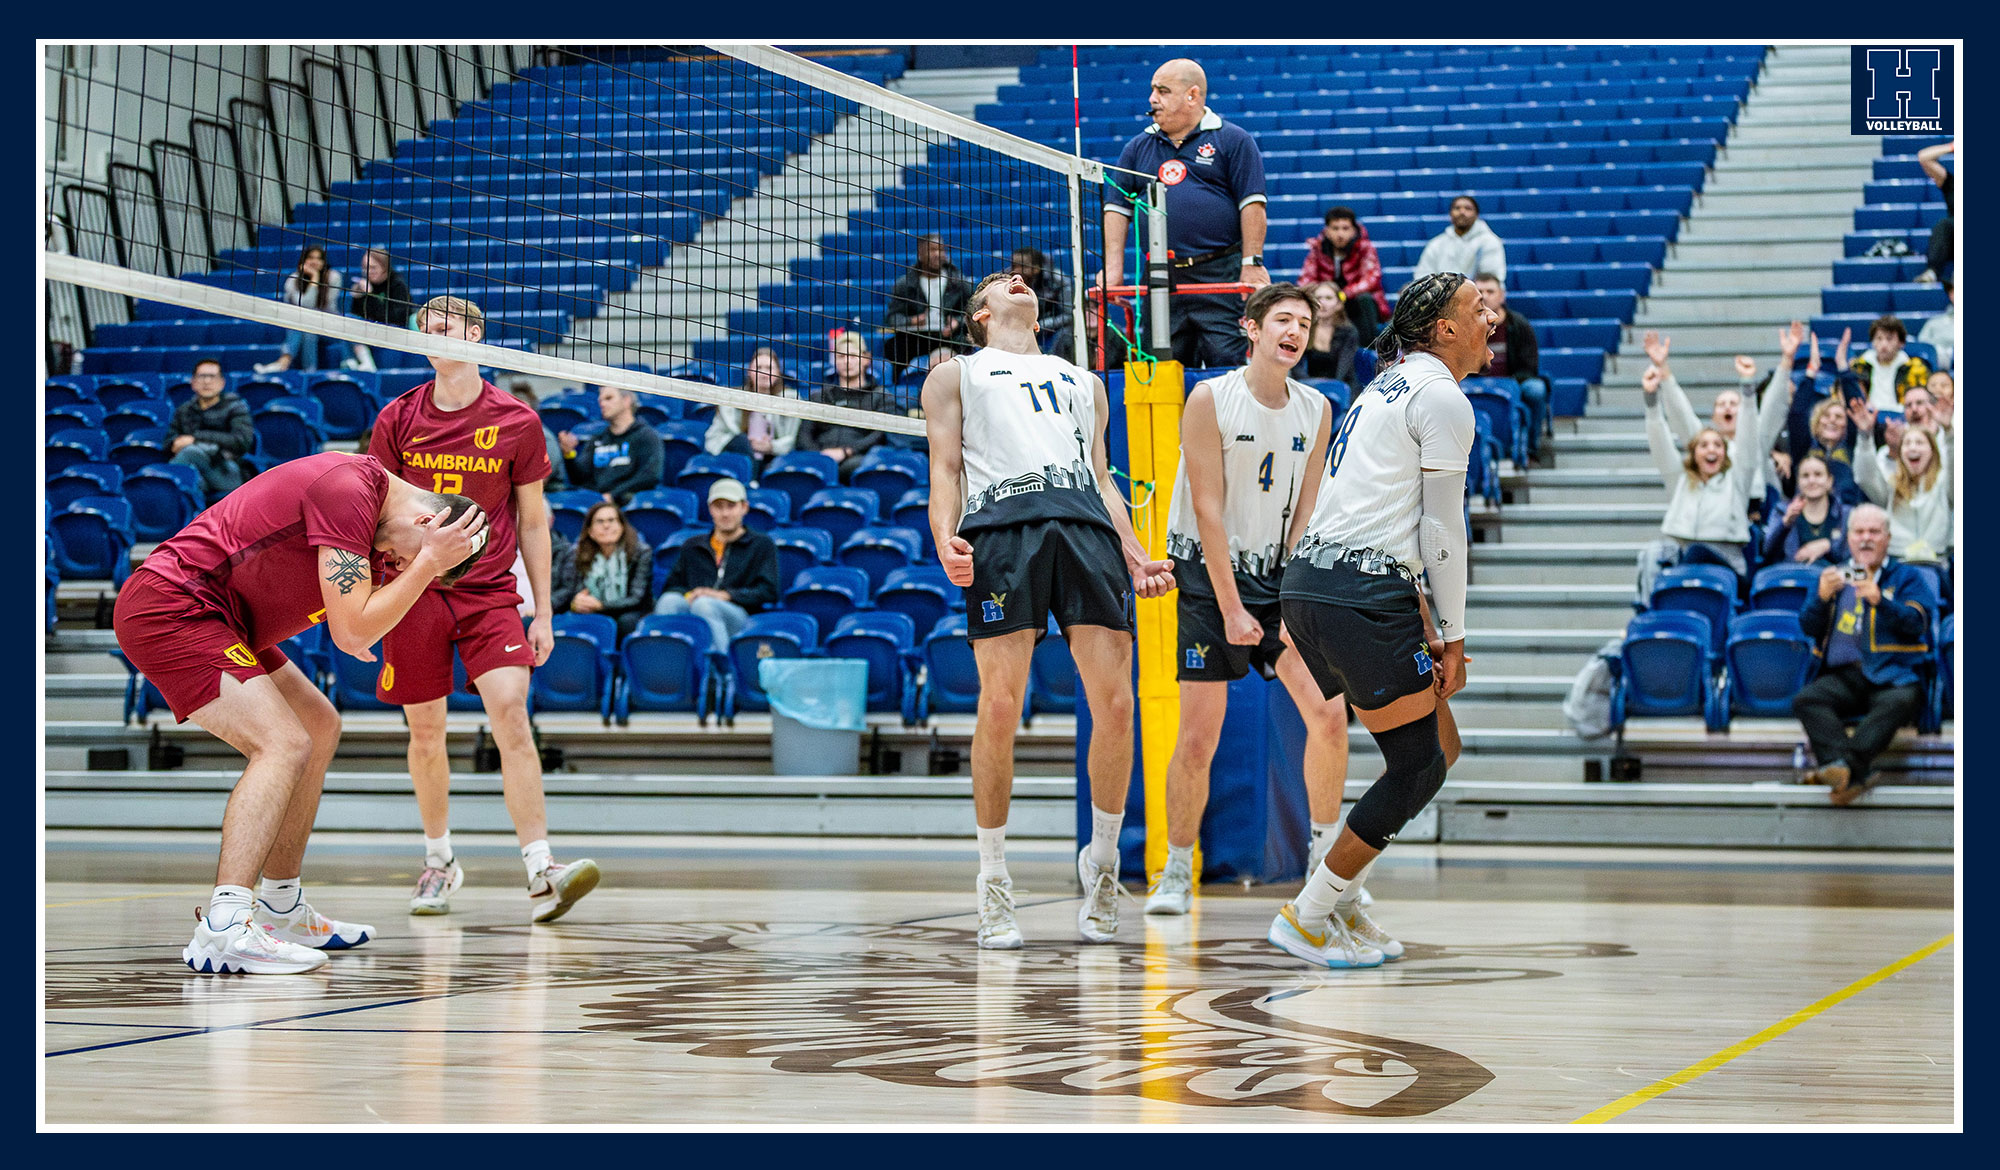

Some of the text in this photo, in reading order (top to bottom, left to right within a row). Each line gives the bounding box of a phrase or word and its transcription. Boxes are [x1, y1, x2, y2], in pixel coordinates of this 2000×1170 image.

[1020, 381, 1061, 414] 11
[1330, 404, 1363, 478] 8
[402, 451, 502, 473] CAMBRIAN
[1258, 451, 1275, 492] 4
[981, 600, 1005, 623] H
[1186, 648, 1205, 668] H
